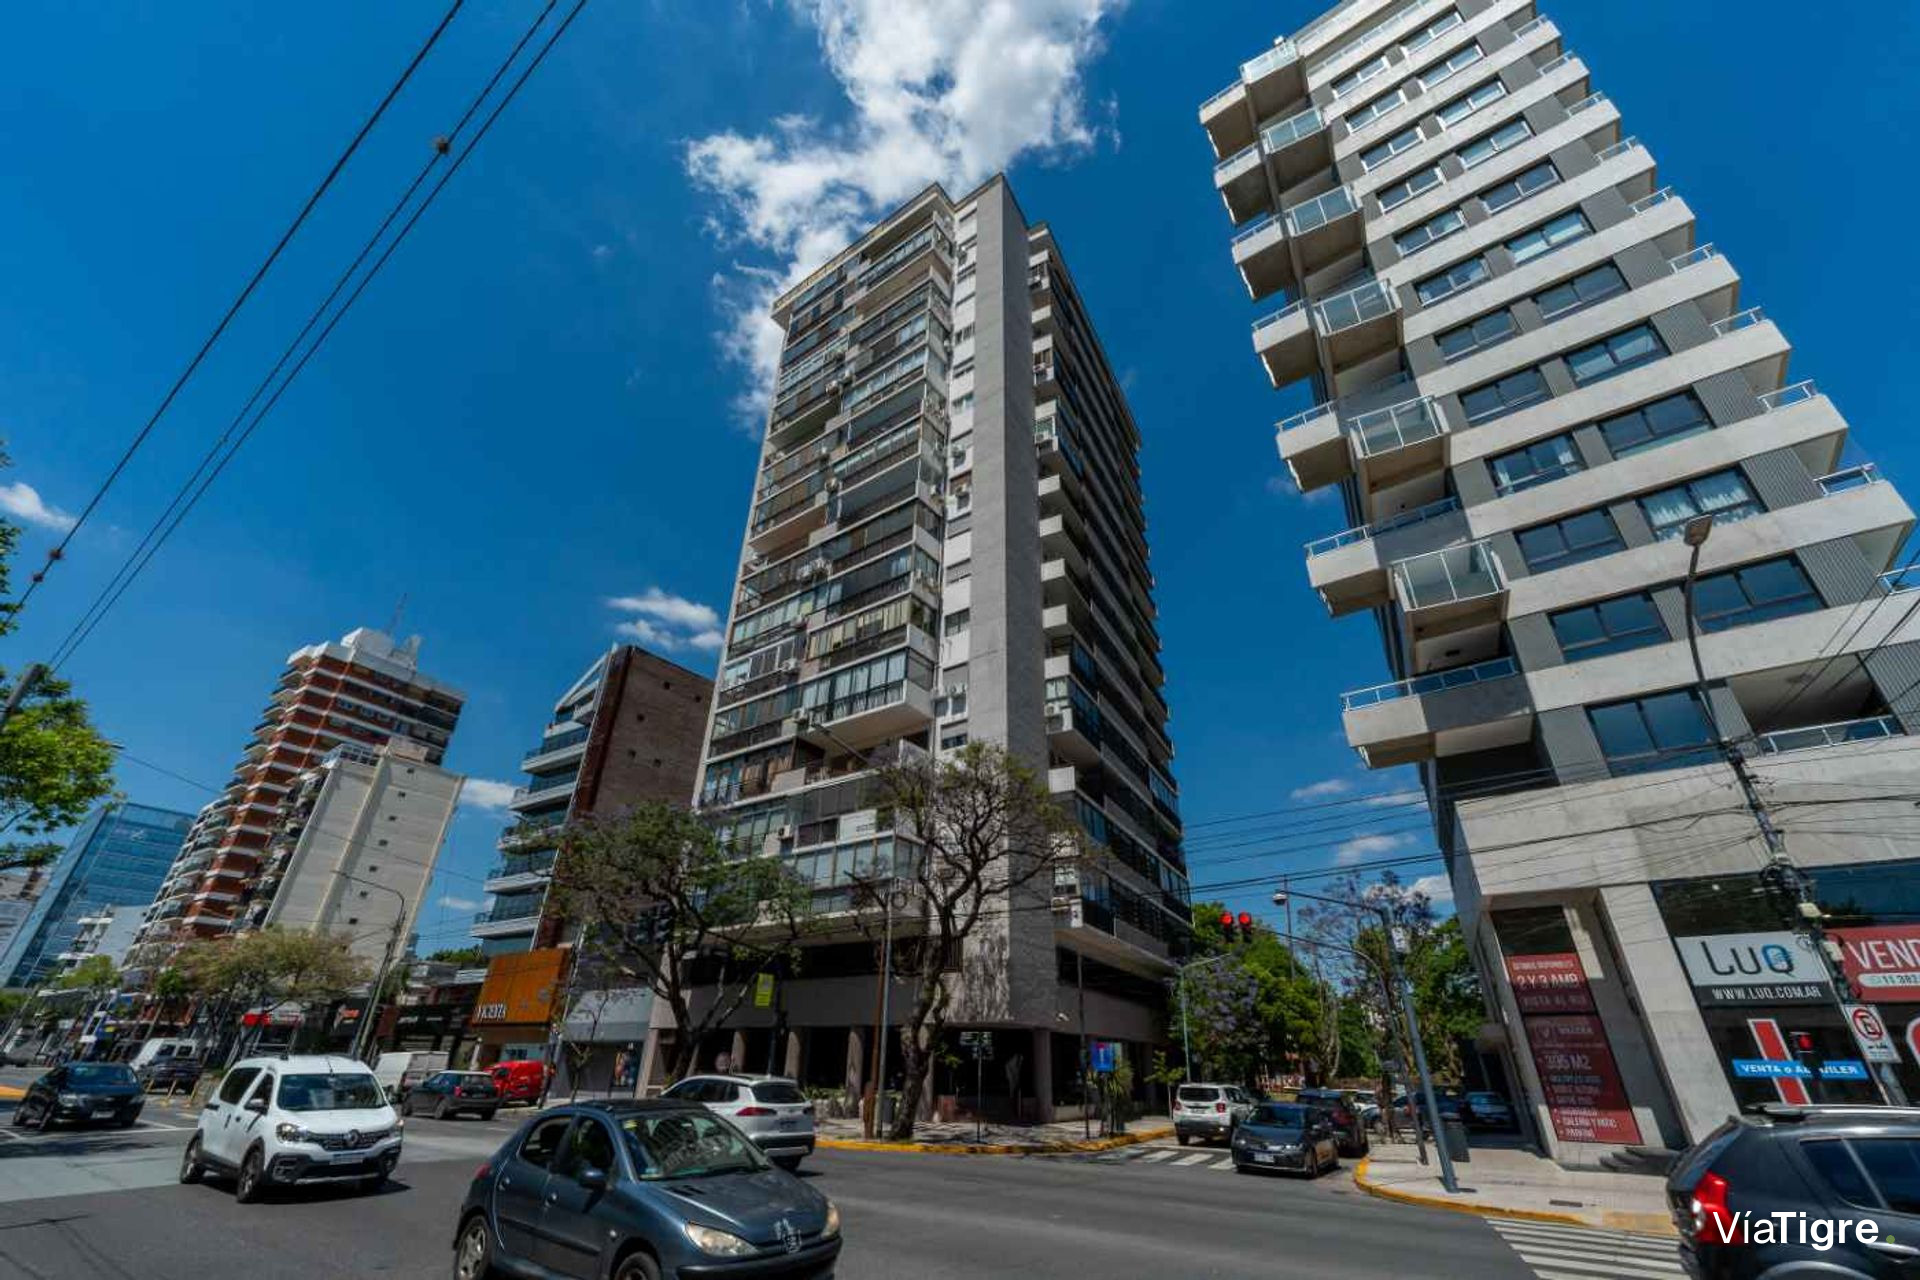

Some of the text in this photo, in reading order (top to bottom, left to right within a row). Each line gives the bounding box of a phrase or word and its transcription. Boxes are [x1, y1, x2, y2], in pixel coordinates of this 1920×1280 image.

[1701, 941, 1796, 977] LUQ
[1712, 986, 1821, 1000] WWW.LUQ.COM.AR
[1740, 1064, 1780, 1073] VENTA
